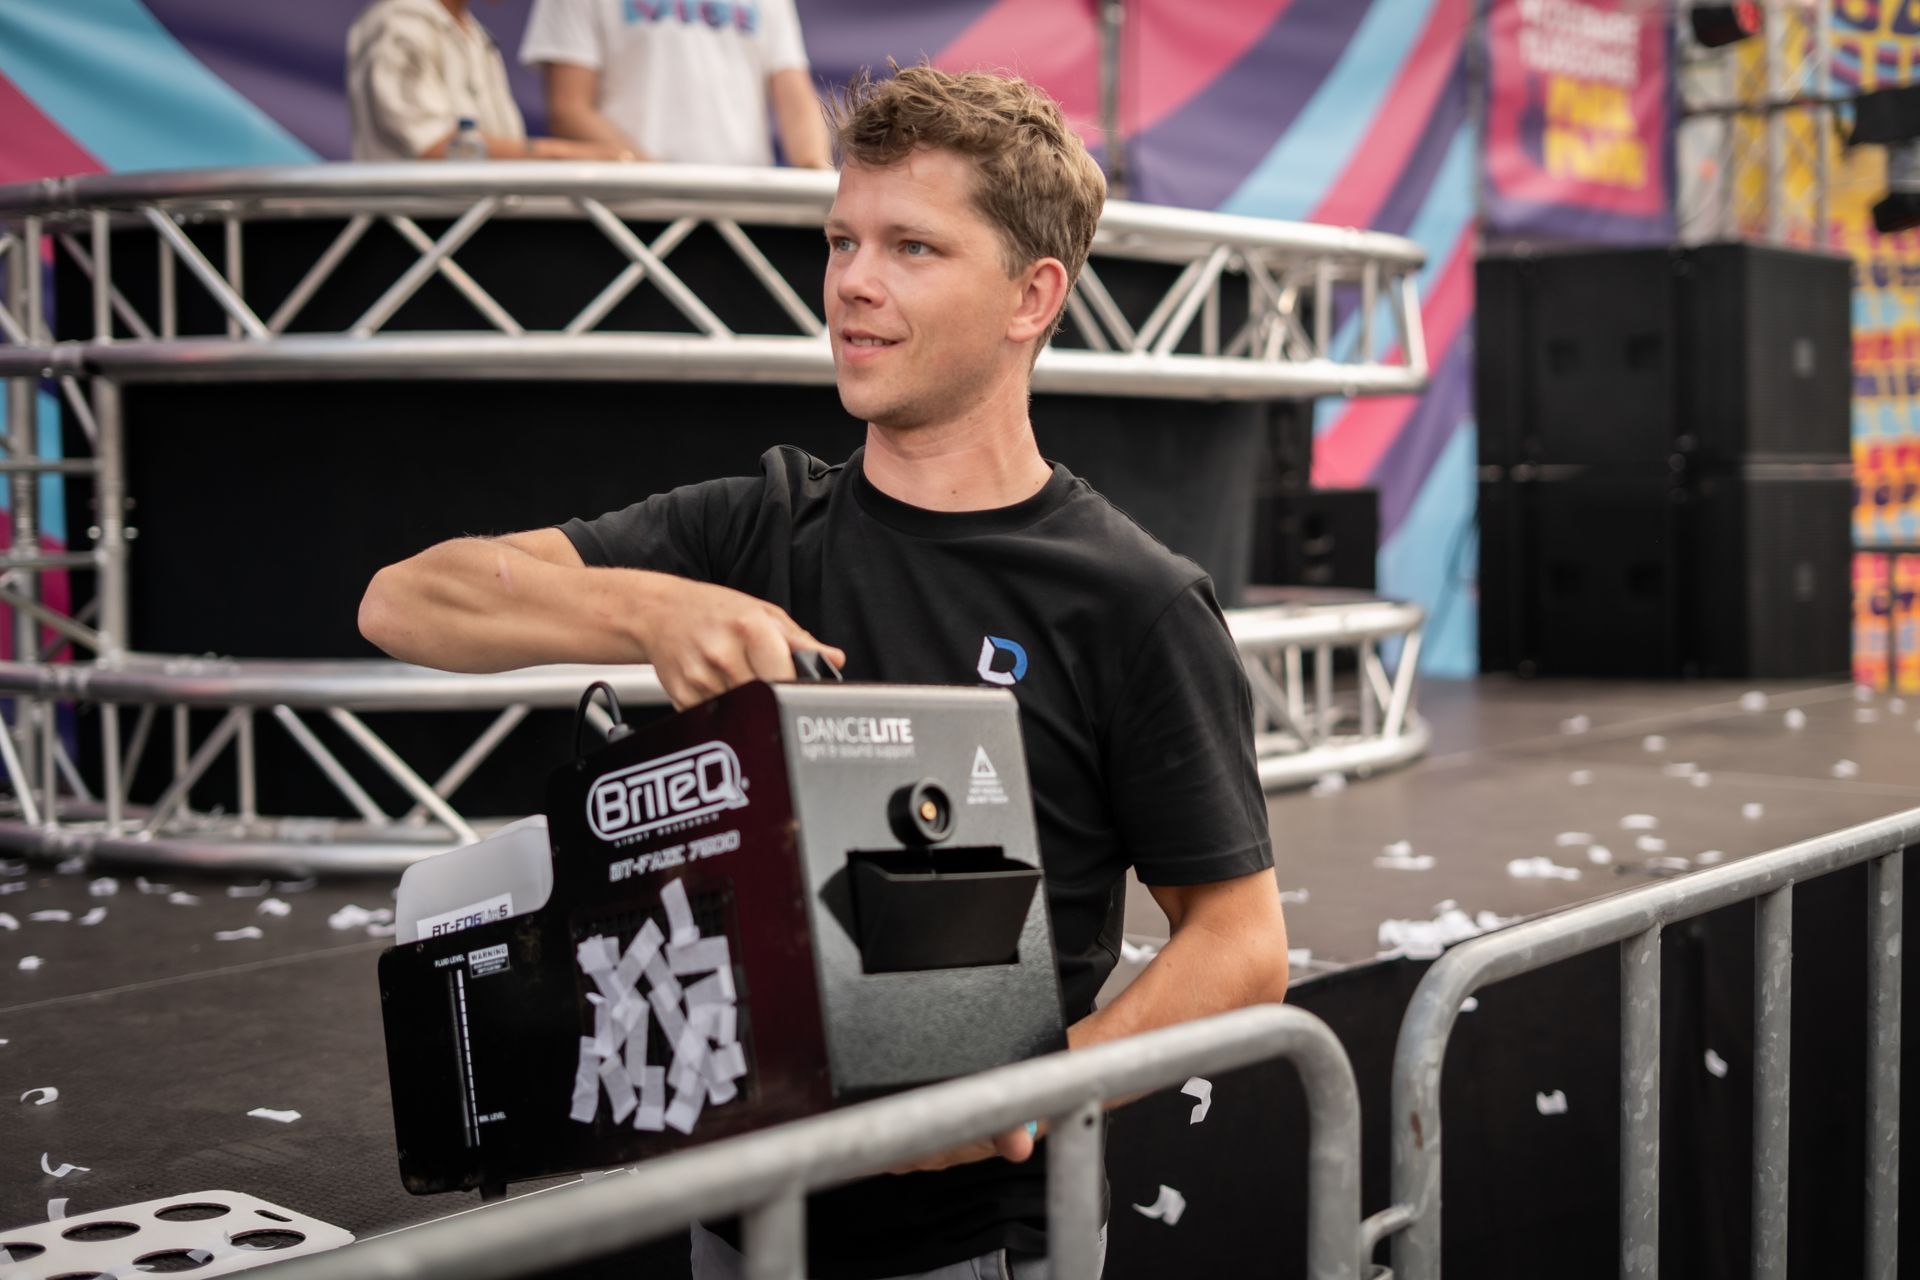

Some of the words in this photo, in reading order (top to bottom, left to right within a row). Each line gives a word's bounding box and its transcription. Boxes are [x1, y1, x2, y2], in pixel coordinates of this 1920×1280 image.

[798, 716, 914, 743] DANCELITE
[450, 954, 465, 965] LEVEL
[471, 947, 507, 961] WARNING
